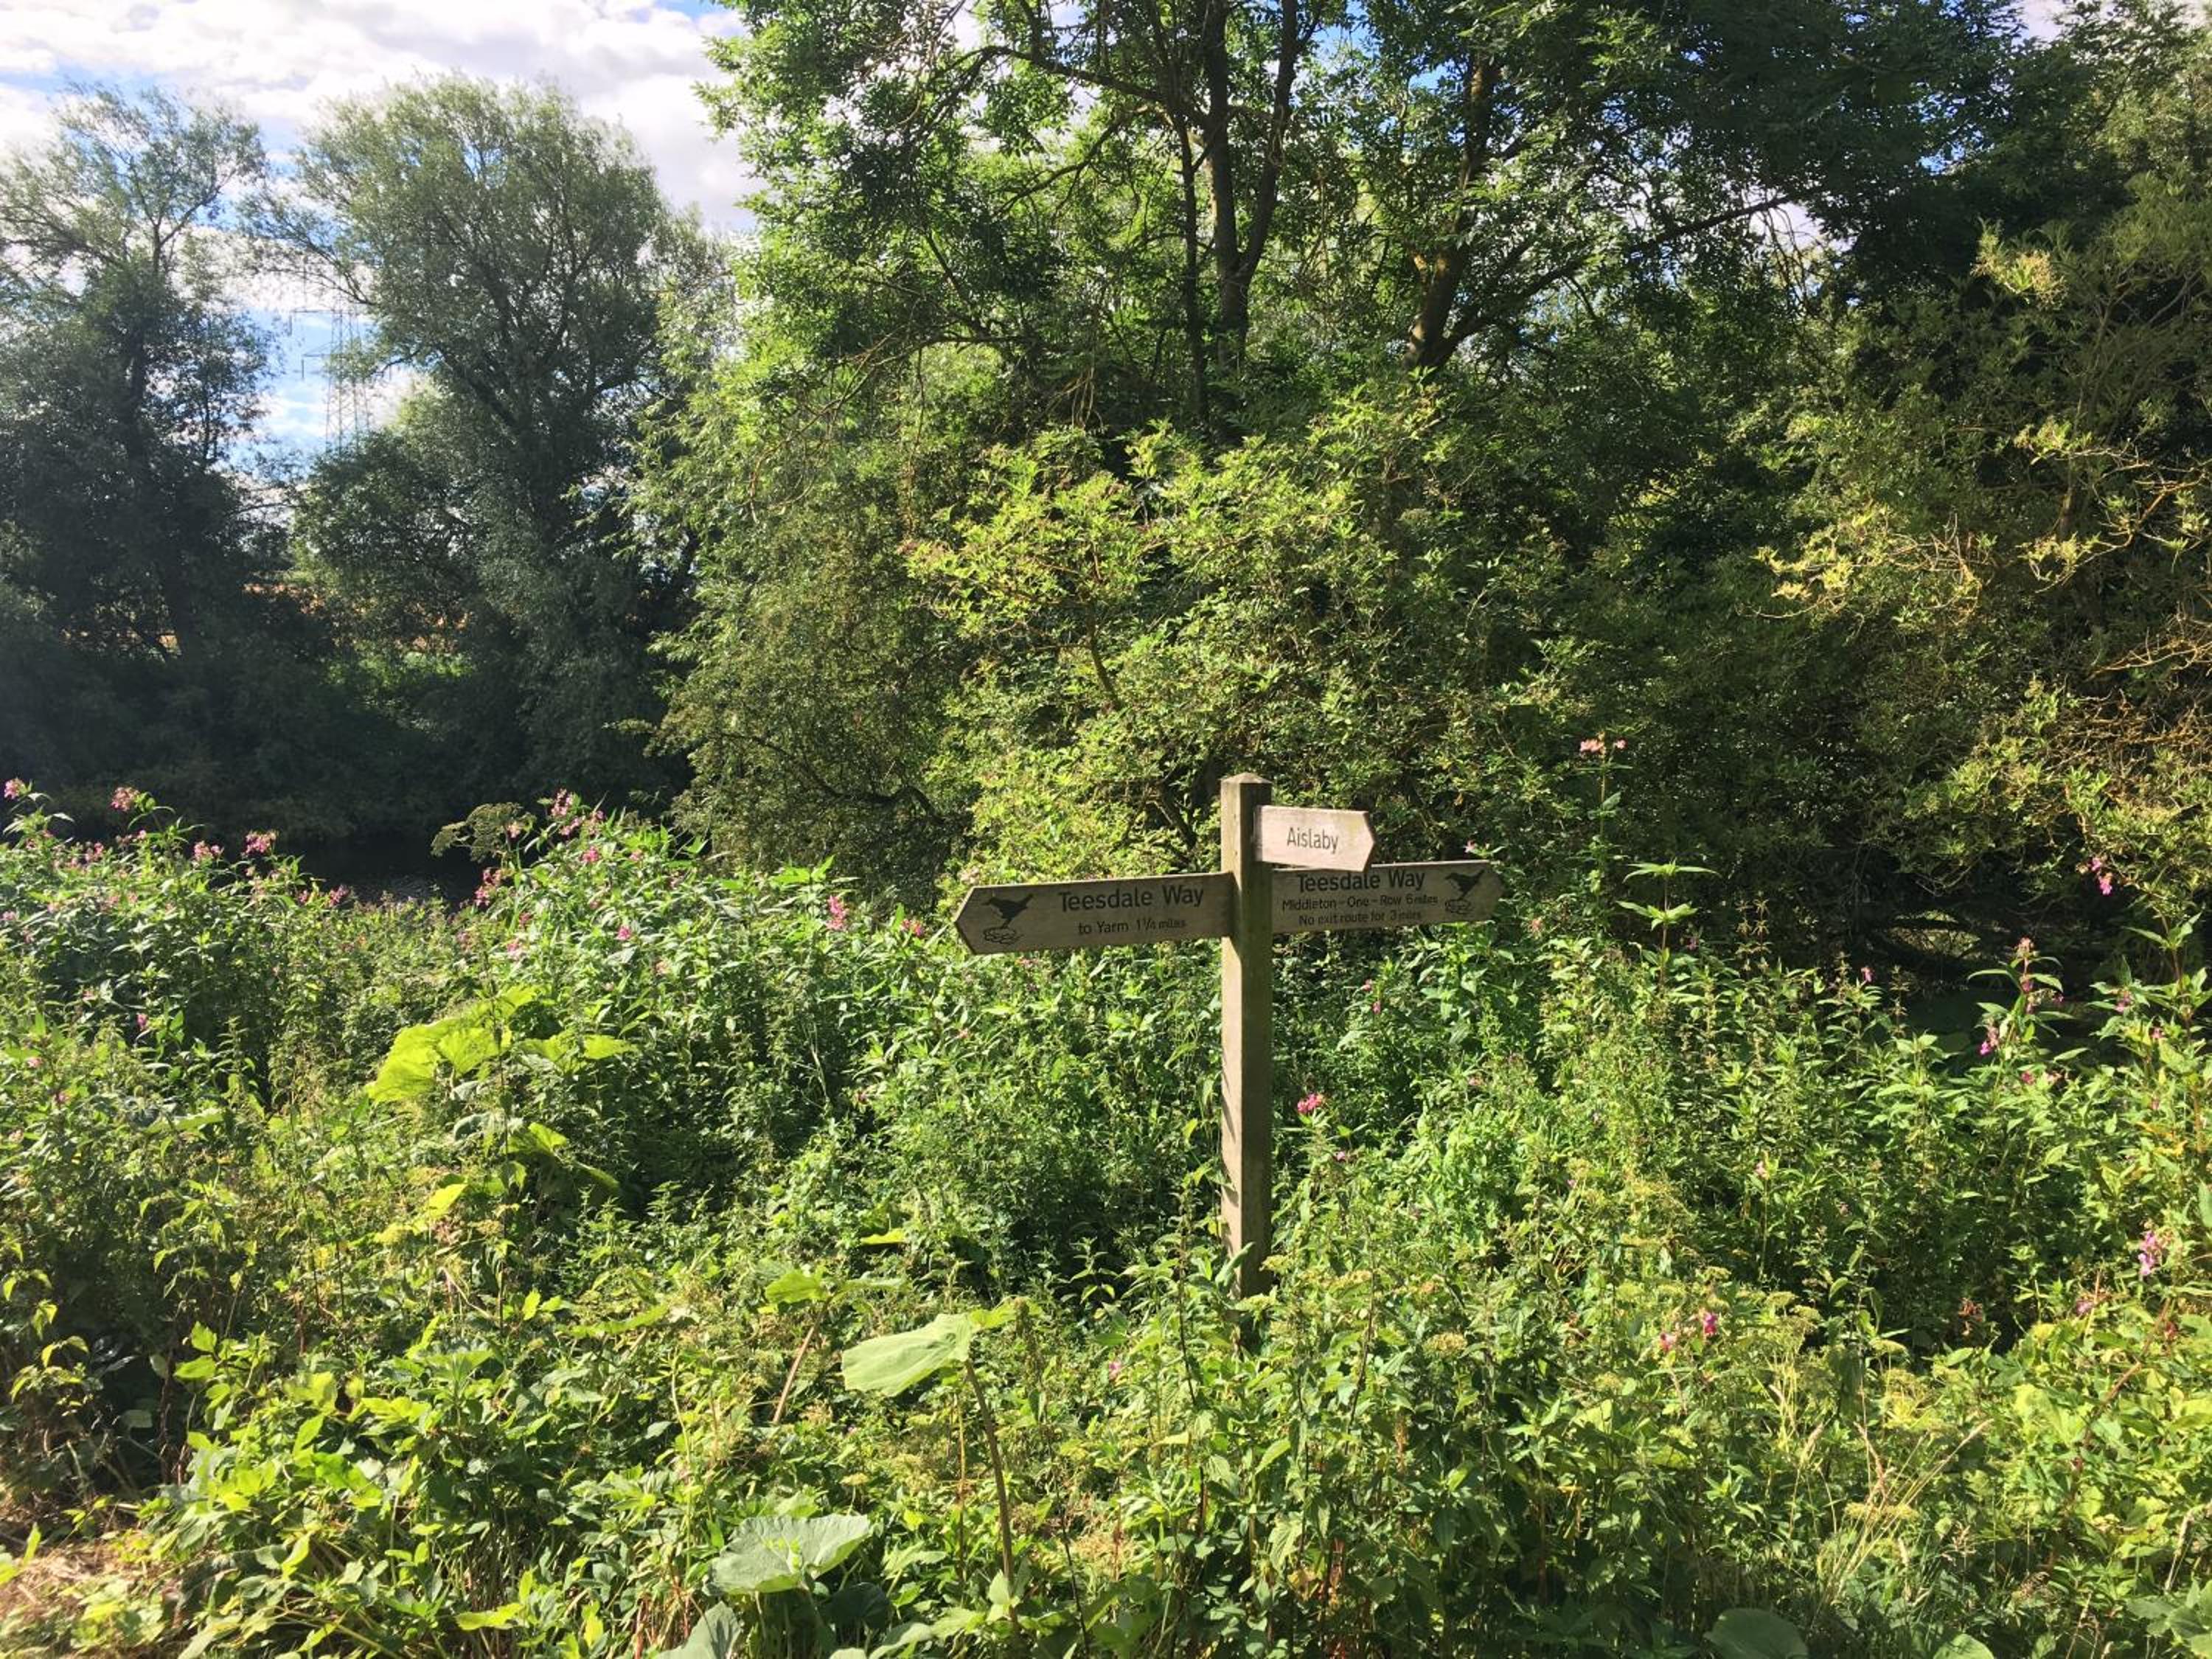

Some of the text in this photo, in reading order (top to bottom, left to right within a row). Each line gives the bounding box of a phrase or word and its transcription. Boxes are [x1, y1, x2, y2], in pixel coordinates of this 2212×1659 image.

[1286, 827, 1340, 855] Aislaby
[1297, 869, 1426, 894] Teesdale Way
[1058, 883, 1204, 913] Teesdale Way
[1078, 922, 1092, 935] to
[1096, 920, 1129, 933] Yarm
[1158, 918, 1186, 930] miles
[1298, 914, 1315, 926] No
[1318, 913, 1338, 925] exit
[1339, 911, 1368, 923] route
[1371, 910, 1385, 922] for
[1390, 909, 1397, 921] 3
